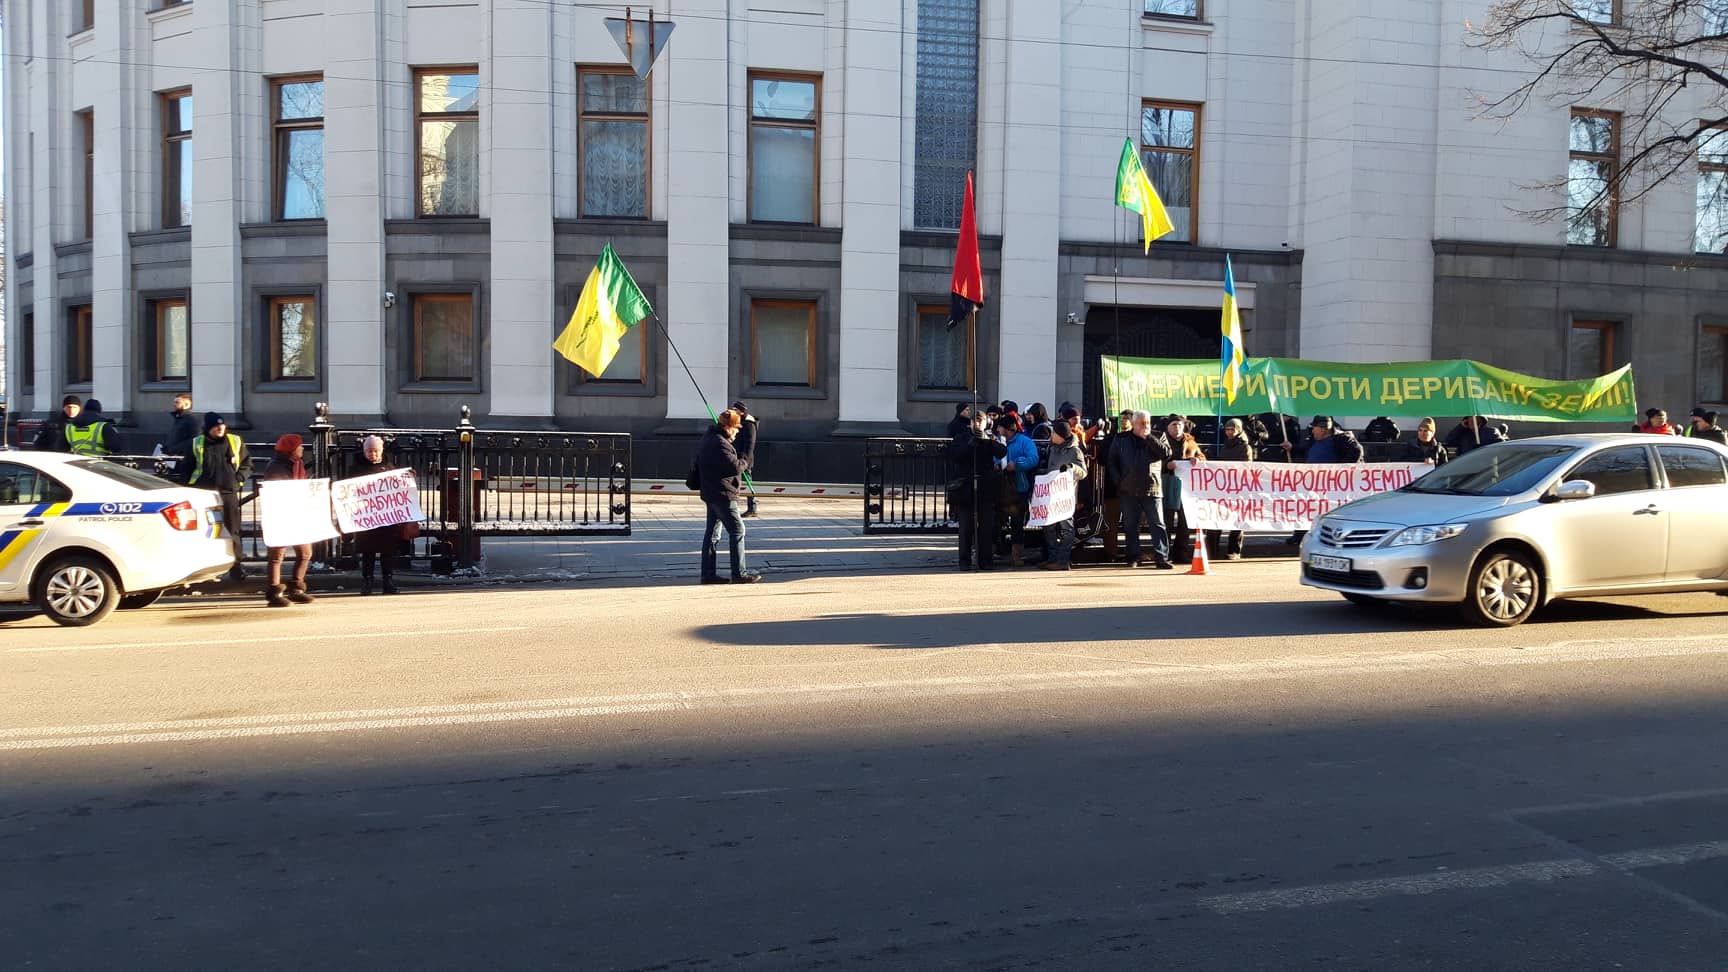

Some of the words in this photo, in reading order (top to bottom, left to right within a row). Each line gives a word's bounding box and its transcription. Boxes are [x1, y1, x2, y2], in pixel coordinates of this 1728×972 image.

[1274, 374, 1372, 400] ПРОТИ
[1380, 375, 1535, 406] ДЕРИБАНУ
[1190, 468, 1264, 495] ПРОДАЖ
[1271, 466, 1356, 495] НАРОДНОЇ
[118, 503, 142, 512] 102
